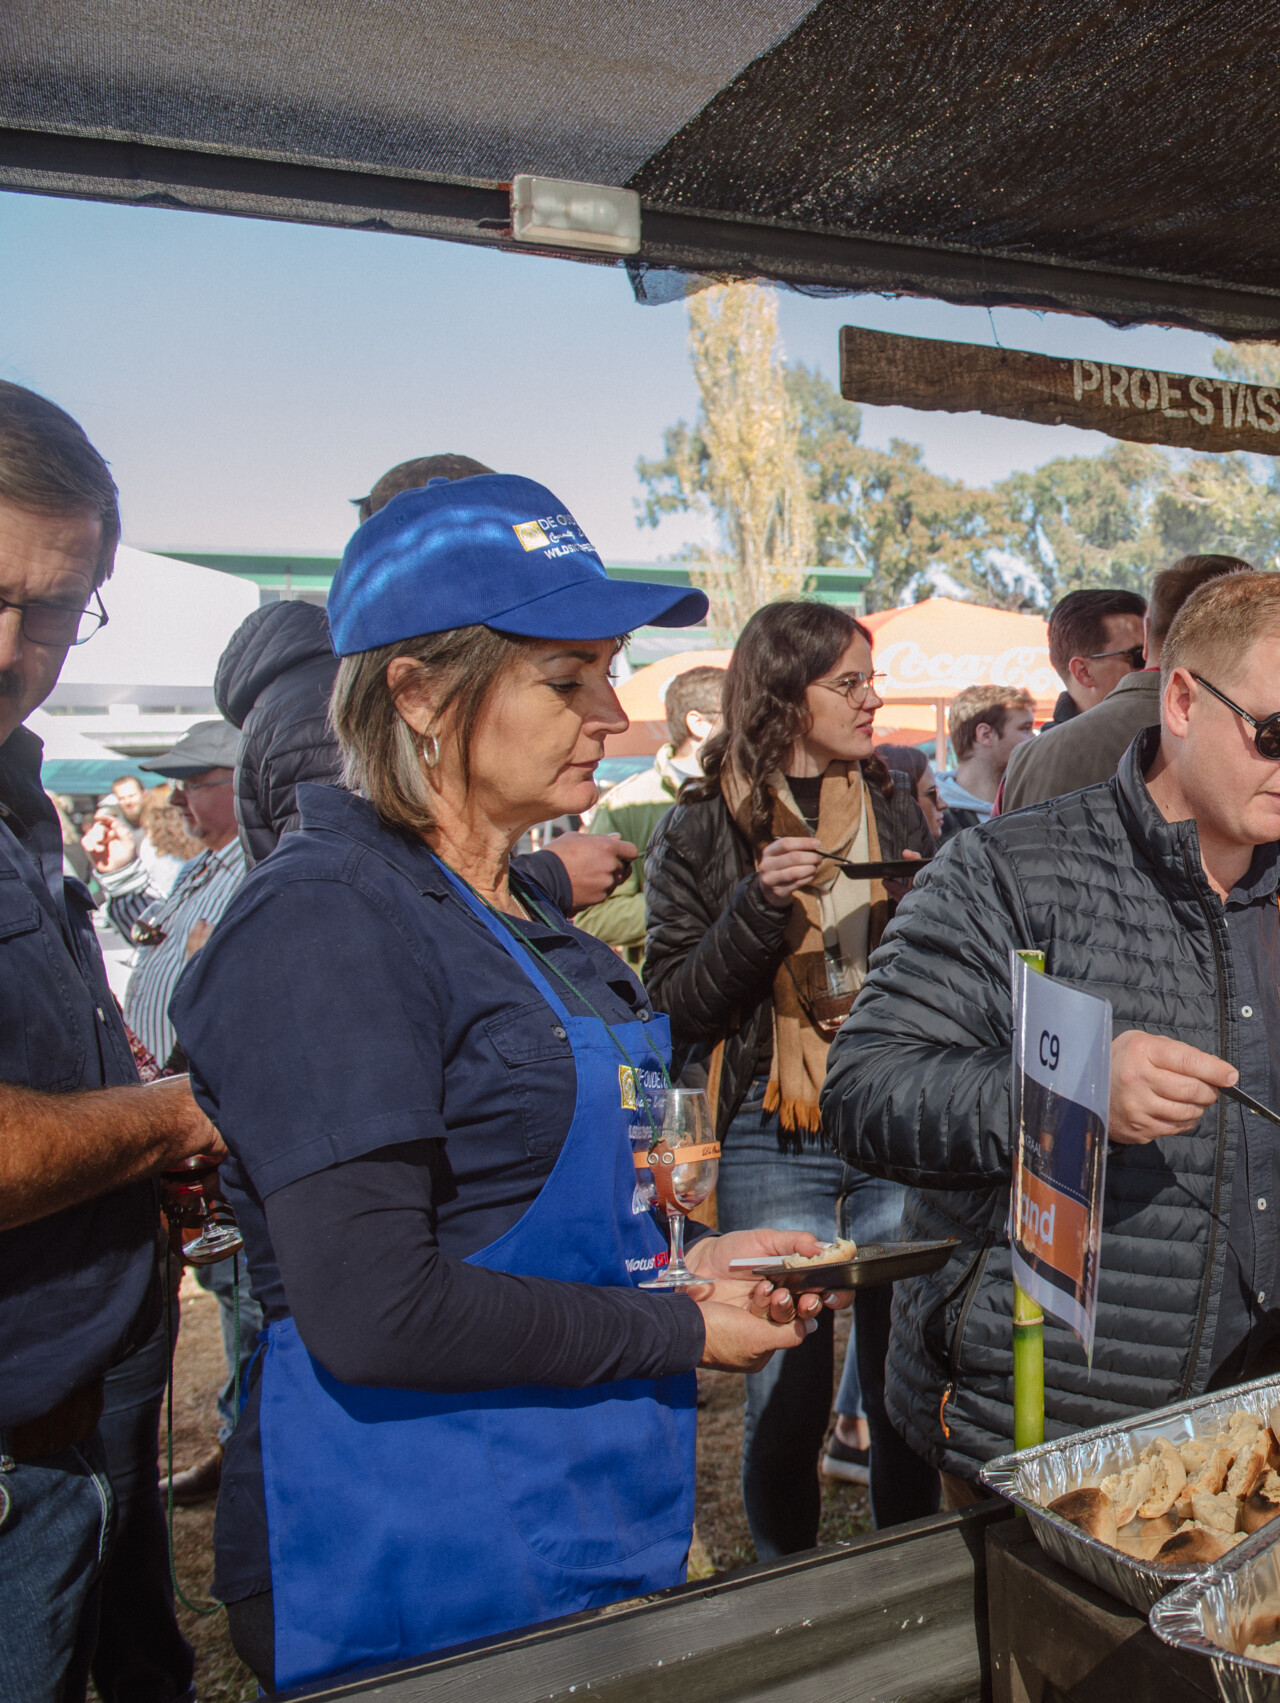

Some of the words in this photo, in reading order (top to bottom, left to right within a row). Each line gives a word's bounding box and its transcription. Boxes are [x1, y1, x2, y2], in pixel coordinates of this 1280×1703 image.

[538, 516, 558, 530] DE
[873, 641, 1068, 693] Coca-Co
[1038, 1029, 1061, 1072] C9
